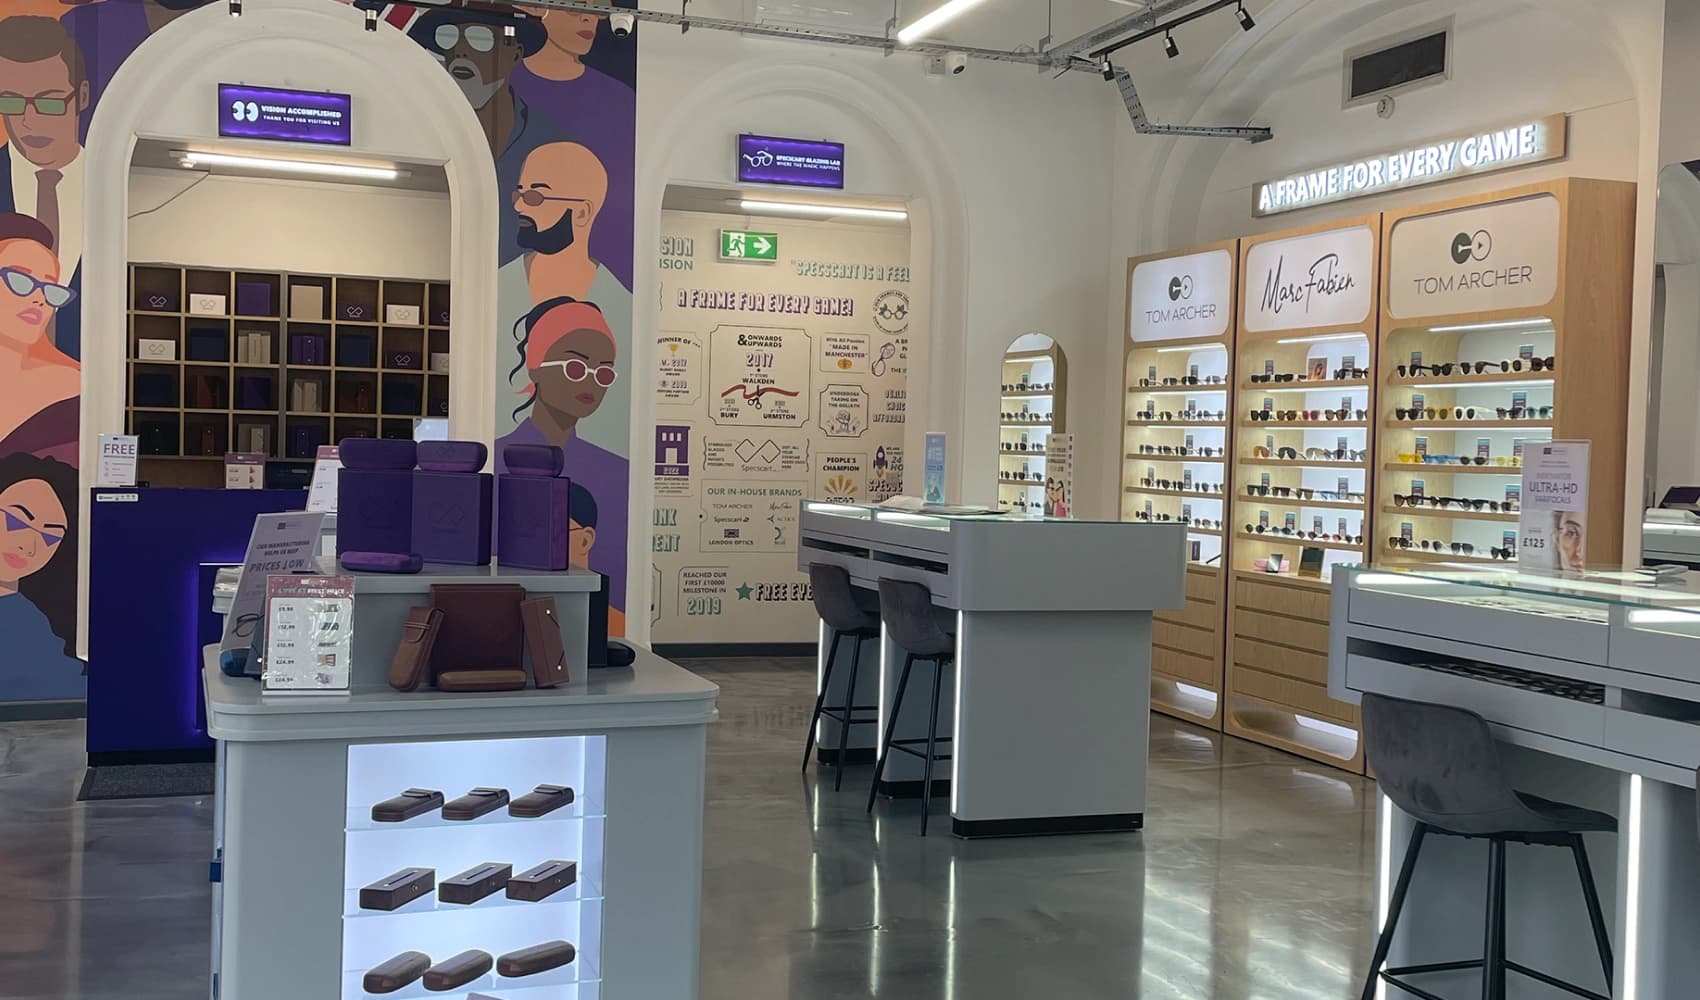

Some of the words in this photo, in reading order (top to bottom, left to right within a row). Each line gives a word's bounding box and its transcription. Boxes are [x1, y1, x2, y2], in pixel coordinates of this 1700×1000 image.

[261, 105, 286, 114] VISION
[287, 107, 342, 118] ACCOMPLISHED
[1259, 184, 1274, 210] A
[1276, 168, 1340, 203] FRAME
[1343, 159, 1386, 191] FOR
[1388, 142, 1456, 183] EVERY
[1460, 124, 1537, 167] GAME
[659, 258, 693, 270] ISION
[863, 265, 875, 280] IS
[1261, 254, 1304, 314] Marc
[1304, 252, 1356, 314] Fabien
[1413, 275, 1454, 295] TOM
[1457, 265, 1533, 290] ARCHER
[678, 288, 687, 308] A
[690, 289, 735, 310] FRAME
[739, 291, 765, 312] FOR
[768, 293, 810, 315] EVERY
[814, 295, 853, 317] GAME!
[1145, 309, 1170, 324] TOM
[1172, 303, 1217, 321] ARCHER
[747, 334, 782, 342] ONWARDS
[747, 340, 782, 348] UPWARDS
[746, 352, 774, 368] 2017
[103, 443, 135, 455] FREE
[826, 456, 857, 464] PEOPLE'S
[707, 487, 726, 496] OUR
[727, 487, 767, 496] IN-HOUSE
[769, 488, 803, 497] BRANDS
[1528, 481, 1578, 495] ULTRA-HD
[1523, 537, 1545, 548] £125
[249, 559, 281, 573] PRICES
[756, 583, 788, 601] FREE
[687, 598, 722, 615] 2019
